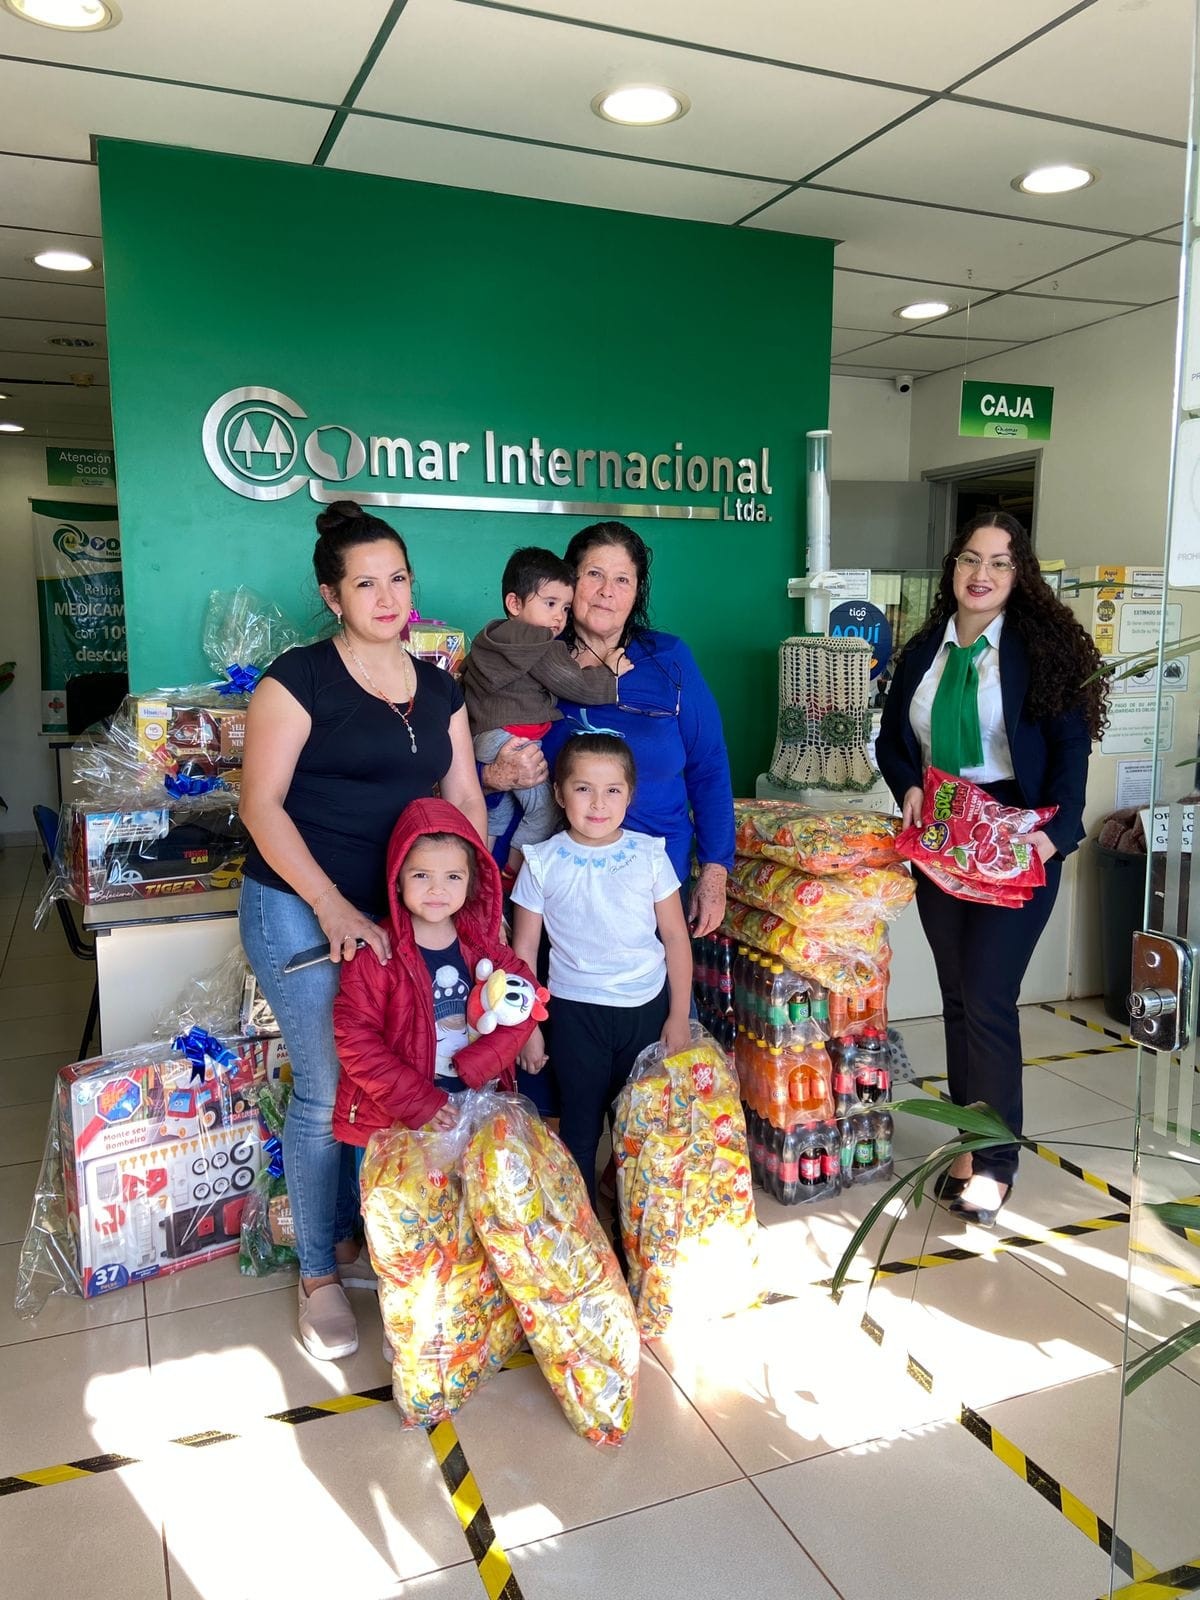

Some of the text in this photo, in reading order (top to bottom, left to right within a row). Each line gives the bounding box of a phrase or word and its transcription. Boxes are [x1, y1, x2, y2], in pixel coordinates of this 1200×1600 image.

[980, 394, 1034, 419] CAJA
[59, 451, 112, 464] Atención
[484, 429, 773, 495] Internacional
[76, 464, 109, 475] Socio
[723, 496, 773, 522] Ltda.
[84, 583, 121, 596] Retirá
[75, 629, 97, 640] con
[832, 623, 881, 644] AQUÍ
[145, 881, 196, 896] TIGER
[103, 1126, 147, 1142] Monte seu
[105, 1136, 146, 1151] Bombeiro
[95, 1265, 119, 1286] 37
